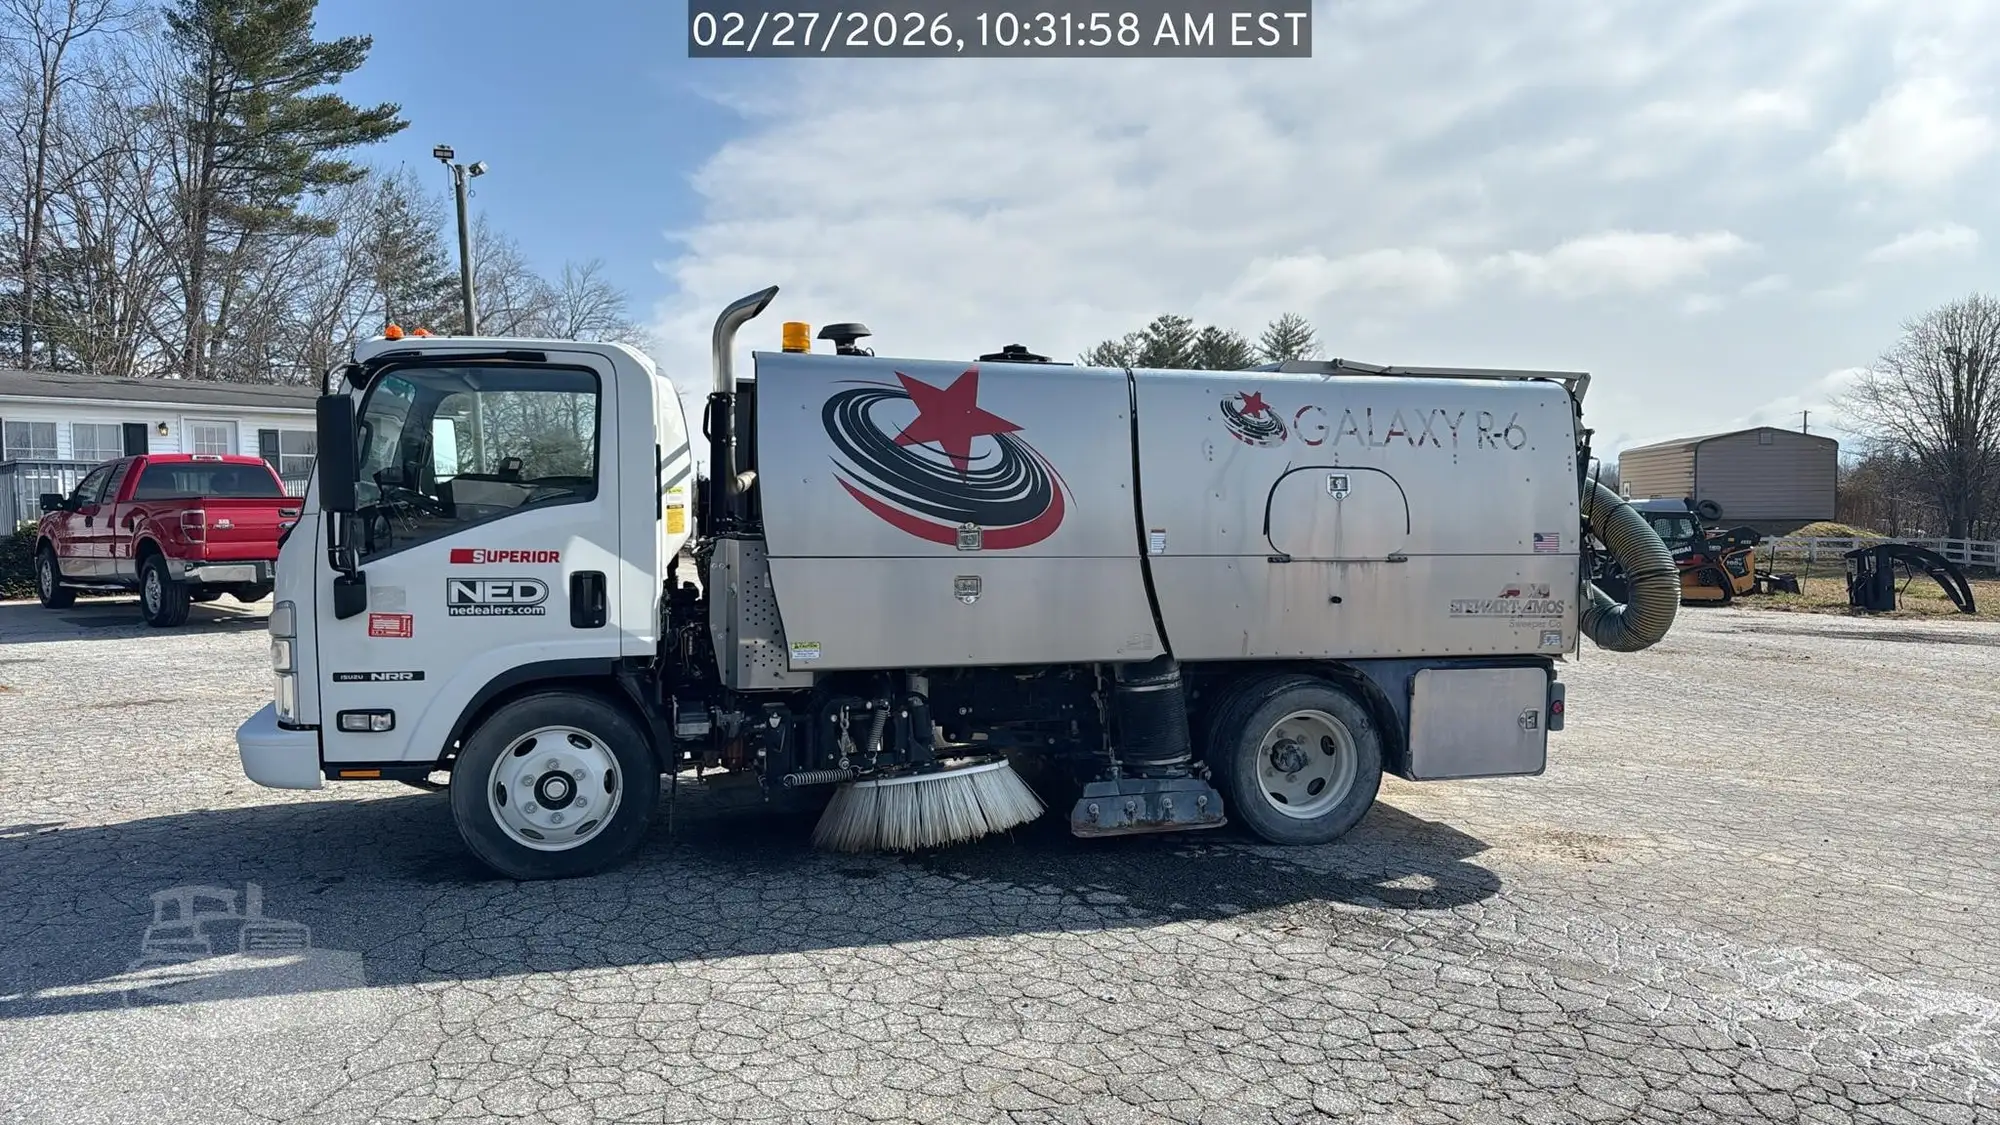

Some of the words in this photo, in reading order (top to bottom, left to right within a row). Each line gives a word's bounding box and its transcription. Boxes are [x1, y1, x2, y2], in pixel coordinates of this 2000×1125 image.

[1293, 404, 1466, 449] GALAXY
[1475, 410, 1528, 451] R-6
[472, 549, 560, 564] SUPERIOR
[449, 580, 546, 603] NED
[449, 605, 546, 616] nedealers.com
[340, 673, 364, 681] ISUZU
[370, 671, 414, 681] NRR
